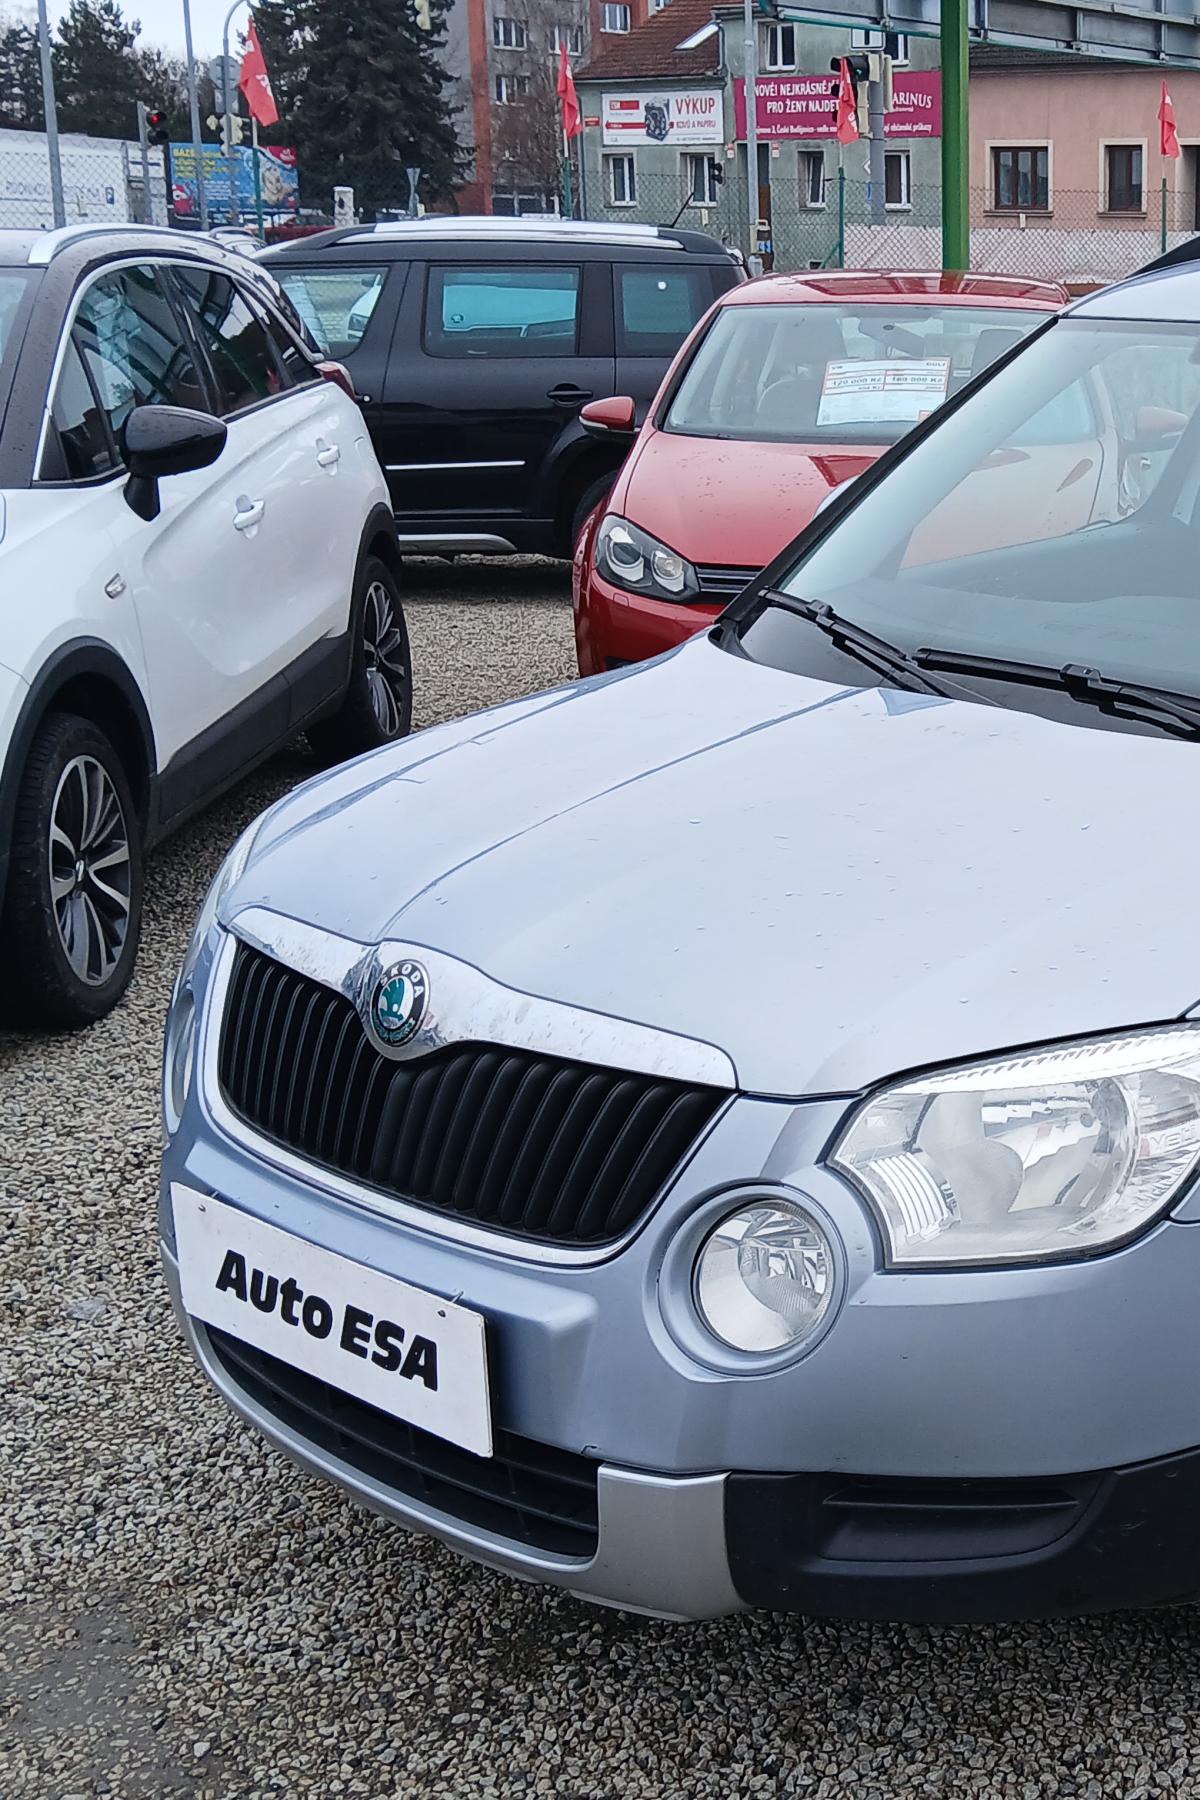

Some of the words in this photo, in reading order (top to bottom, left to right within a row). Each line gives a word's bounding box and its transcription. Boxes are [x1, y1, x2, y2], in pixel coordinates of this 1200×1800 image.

[780, 79, 844, 96] NEJKRÁSNĚJ
[676, 96, 716, 114] VÝKUP
[767, 101, 784, 113] PRO
[786, 98, 807, 112] ŽENY
[809, 100, 840, 112] NAJDET
[893, 92, 933, 108] ARINUS
[215, 1249, 333, 1339] Auto
[340, 1304, 438, 1392] ESA
